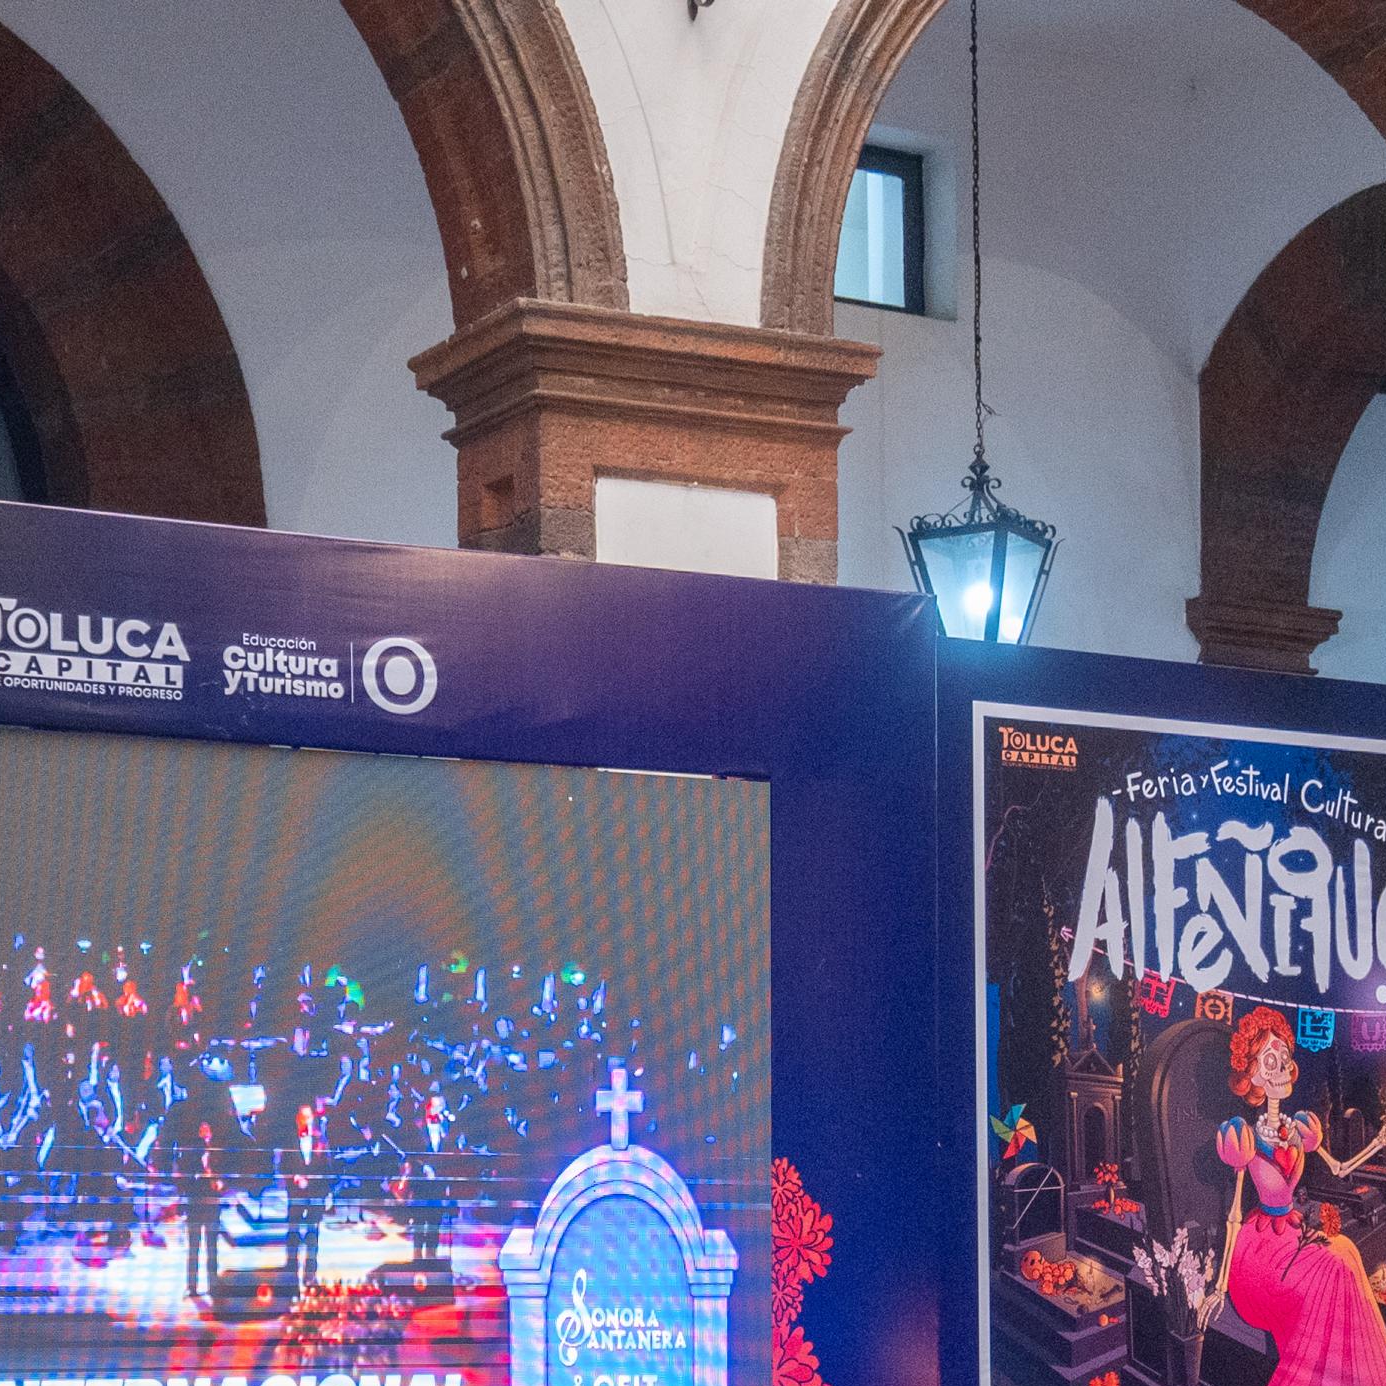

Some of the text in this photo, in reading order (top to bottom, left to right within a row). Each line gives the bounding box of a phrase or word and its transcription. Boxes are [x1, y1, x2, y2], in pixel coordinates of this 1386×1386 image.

[242, 632, 317, 651] Educación
[222, 645, 339, 678] Cultura
[3, 676, 106, 695] OPORTUNIDADES
[107, 685, 117, 696] Y
[118, 685, 183, 701] PROGRESO
[998, 726, 1079, 755] TOLUCA
[1004, 751, 1076, 766] CAPITAL
[1210, 760, 1290, 804] Festival
